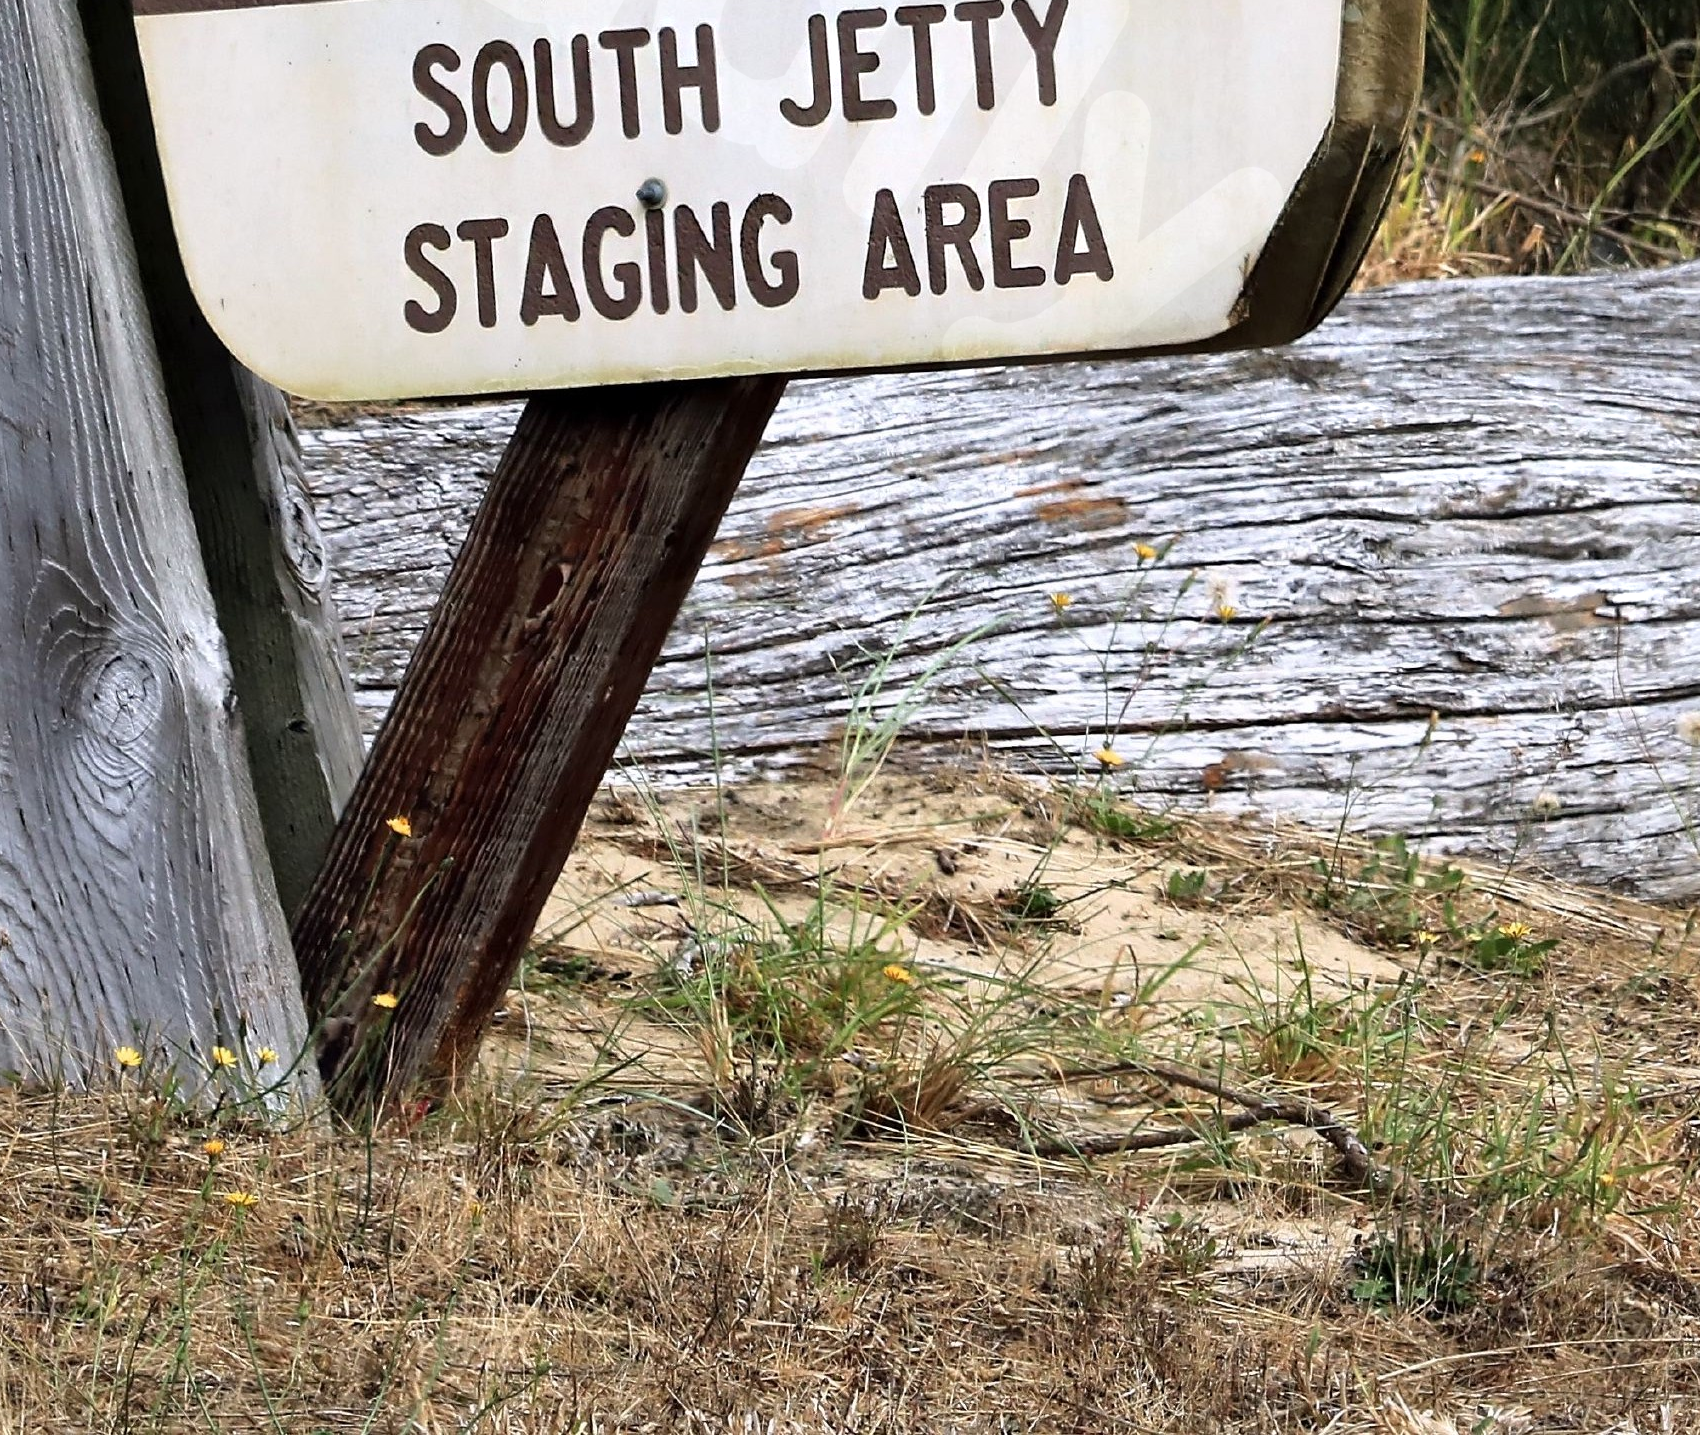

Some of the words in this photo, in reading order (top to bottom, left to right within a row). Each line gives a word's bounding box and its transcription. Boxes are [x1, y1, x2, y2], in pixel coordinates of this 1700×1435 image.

[412, 23, 721, 157] SOUTH
[404, 192, 800, 334] STAGING
[862, 173, 1114, 301] AREA
